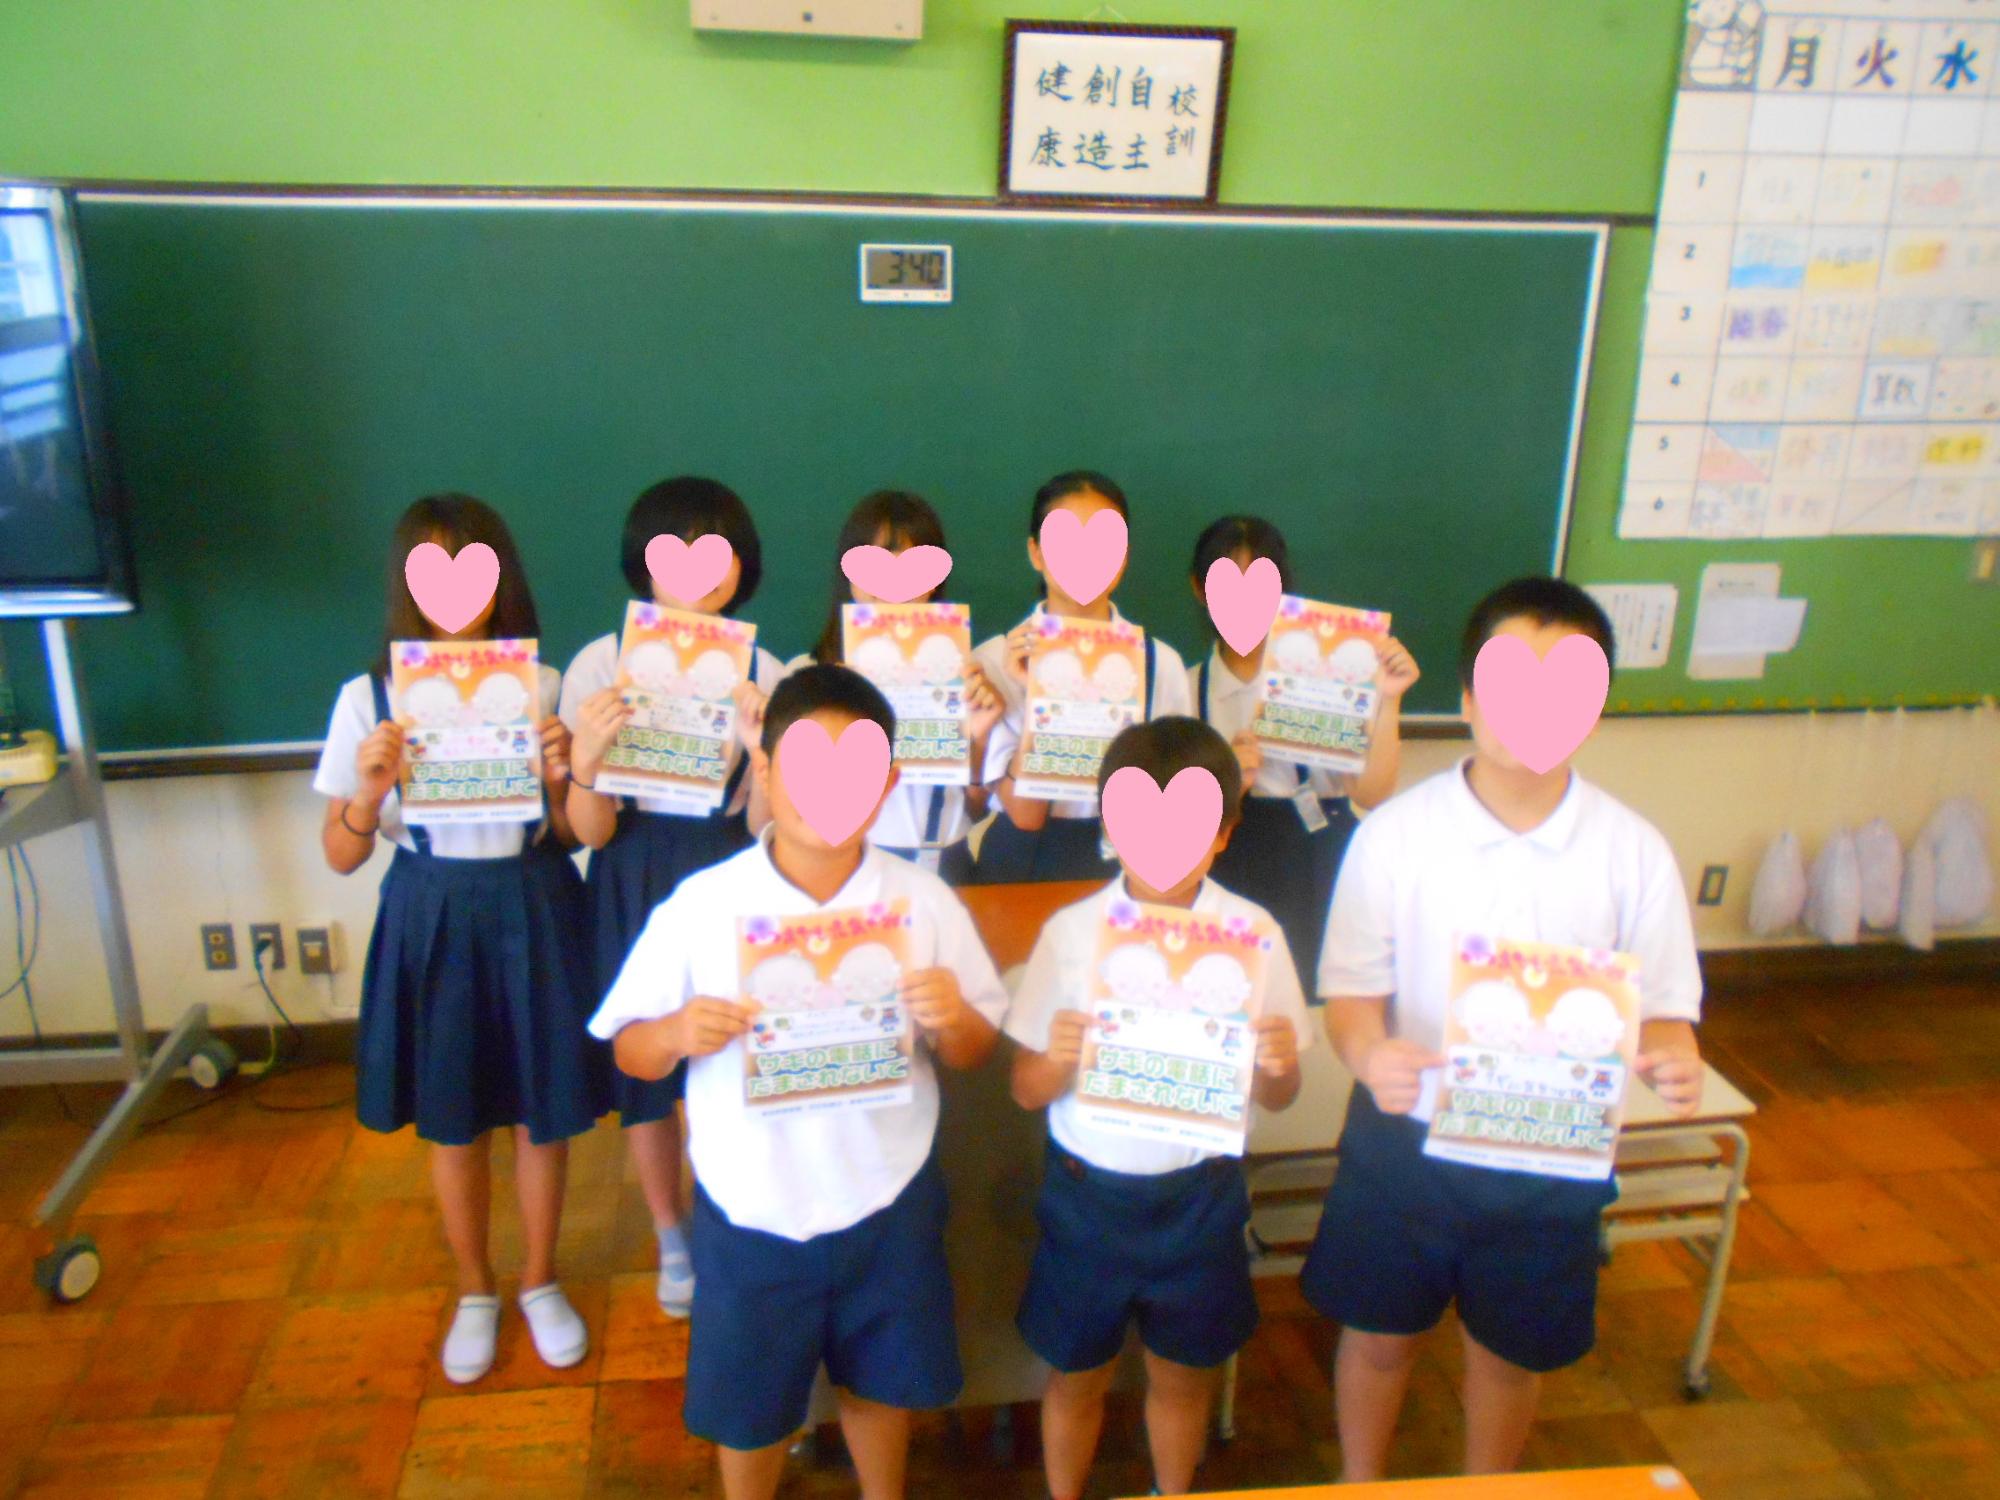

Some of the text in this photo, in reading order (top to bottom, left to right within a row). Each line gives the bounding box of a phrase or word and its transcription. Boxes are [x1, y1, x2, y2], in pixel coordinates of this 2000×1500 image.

[1776, 35, 1980, 90] 月 火 水
[1030, 60, 1075, 169] 健康
[1073, 63, 1123, 171] 創造
[1121, 64, 1154, 171] 自主
[1165, 83, 1200, 157] 校訓
[1683, 242, 1696, 260] 2
[1679, 305, 1692, 322] 3
[1668, 371, 1681, 387] 4
